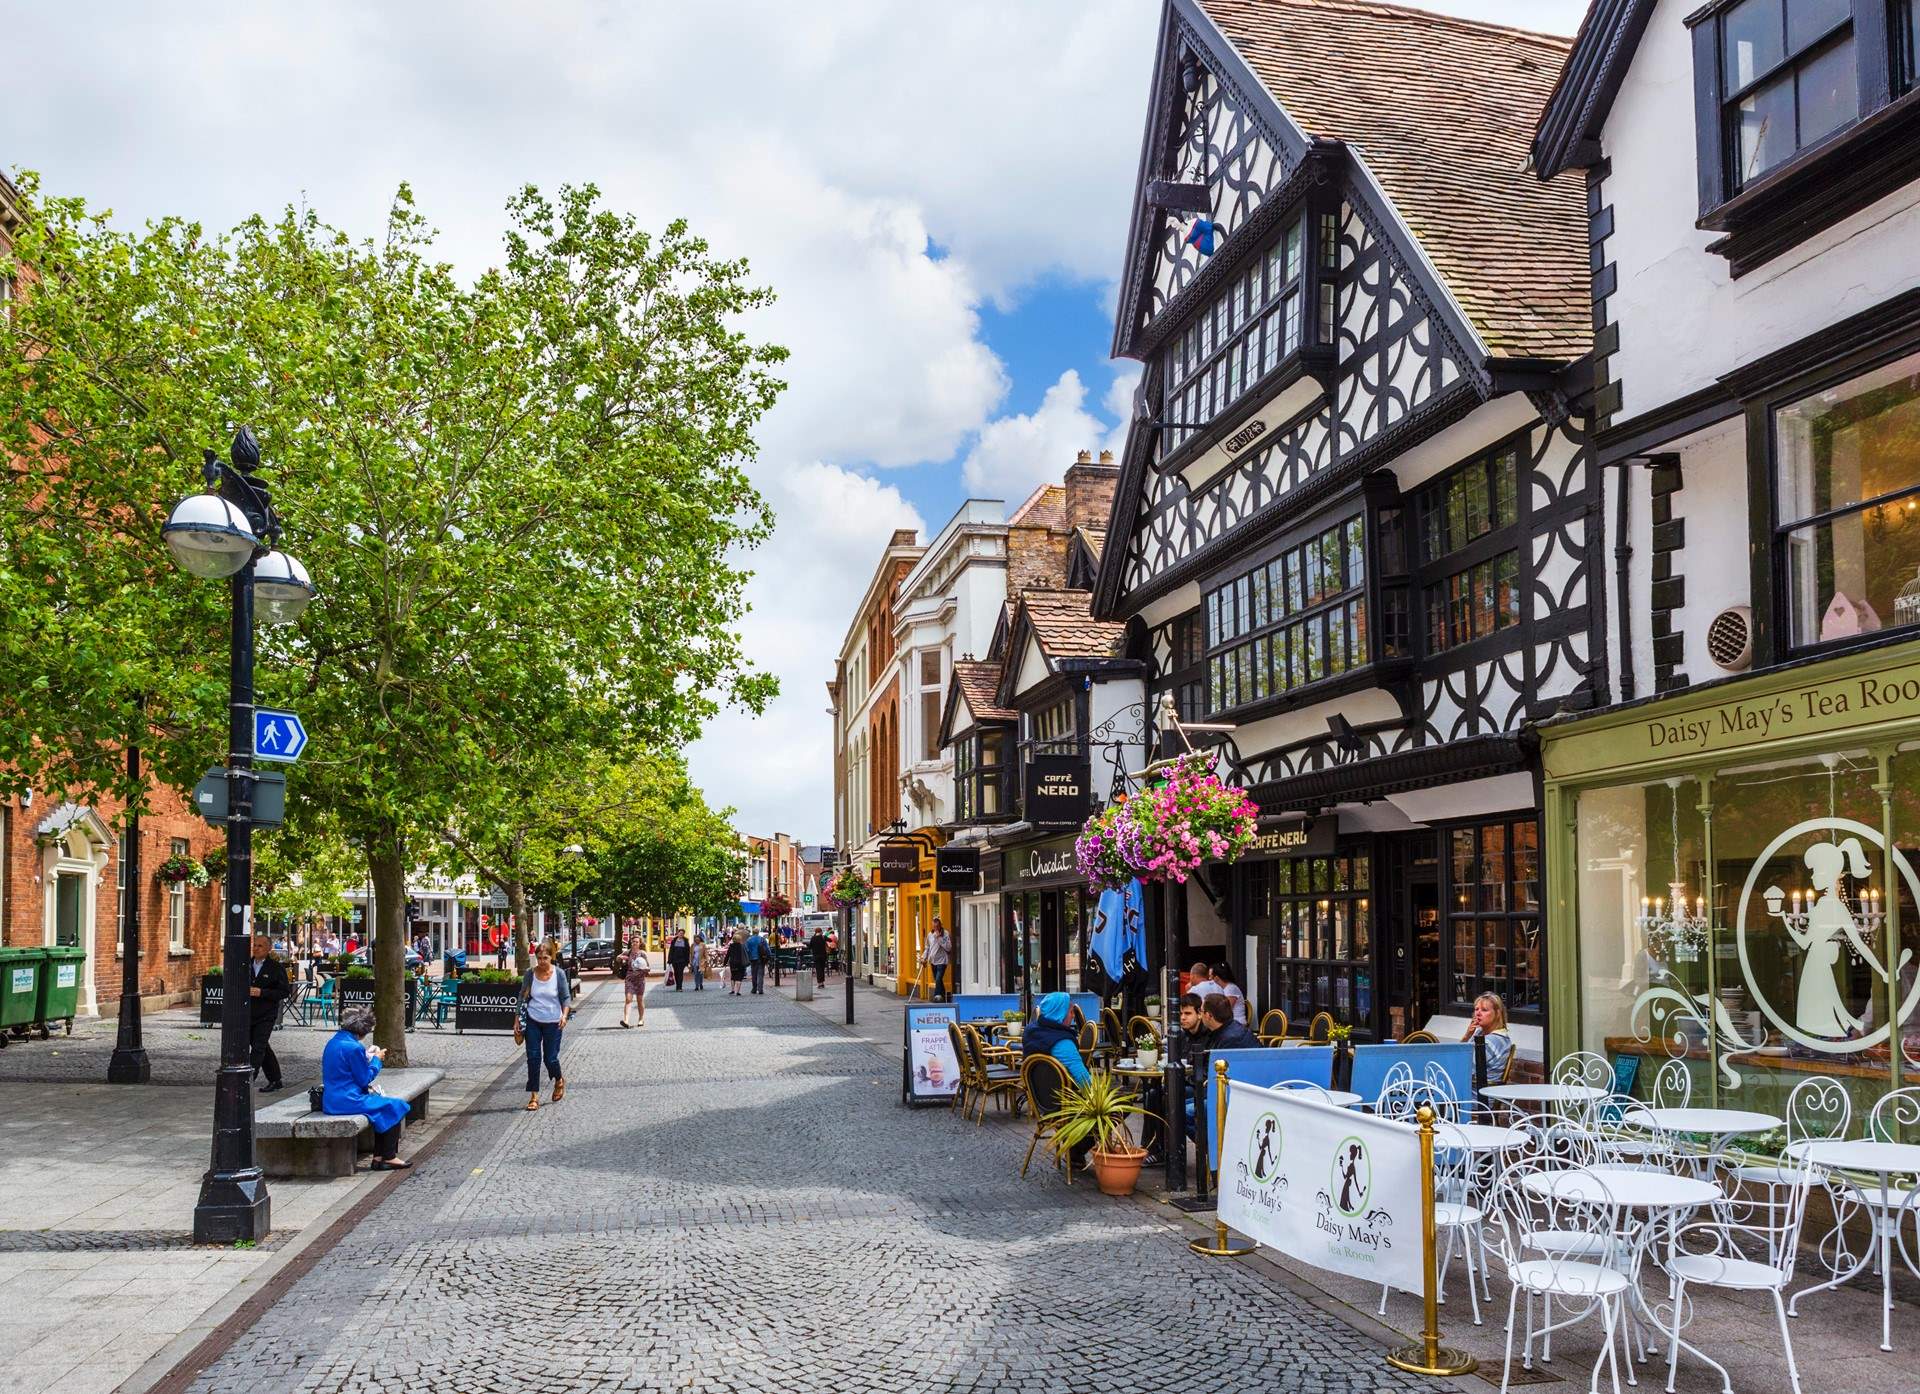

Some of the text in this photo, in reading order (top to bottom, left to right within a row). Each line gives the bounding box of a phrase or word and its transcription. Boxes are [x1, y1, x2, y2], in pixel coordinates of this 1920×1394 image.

[1648, 679, 1920, 747] Daisy May's Tea Roo
[1037, 785, 1079, 796] NERO
[1279, 831, 1307, 847] NERO
[460, 995, 518, 1005] WILDWOO
[917, 1016, 950, 1024] NERO
[1236, 1180, 1282, 1214] Daisy May's
[1316, 1212, 1392, 1251] Daisy May's
[1344, 1246, 1376, 1264] Room
